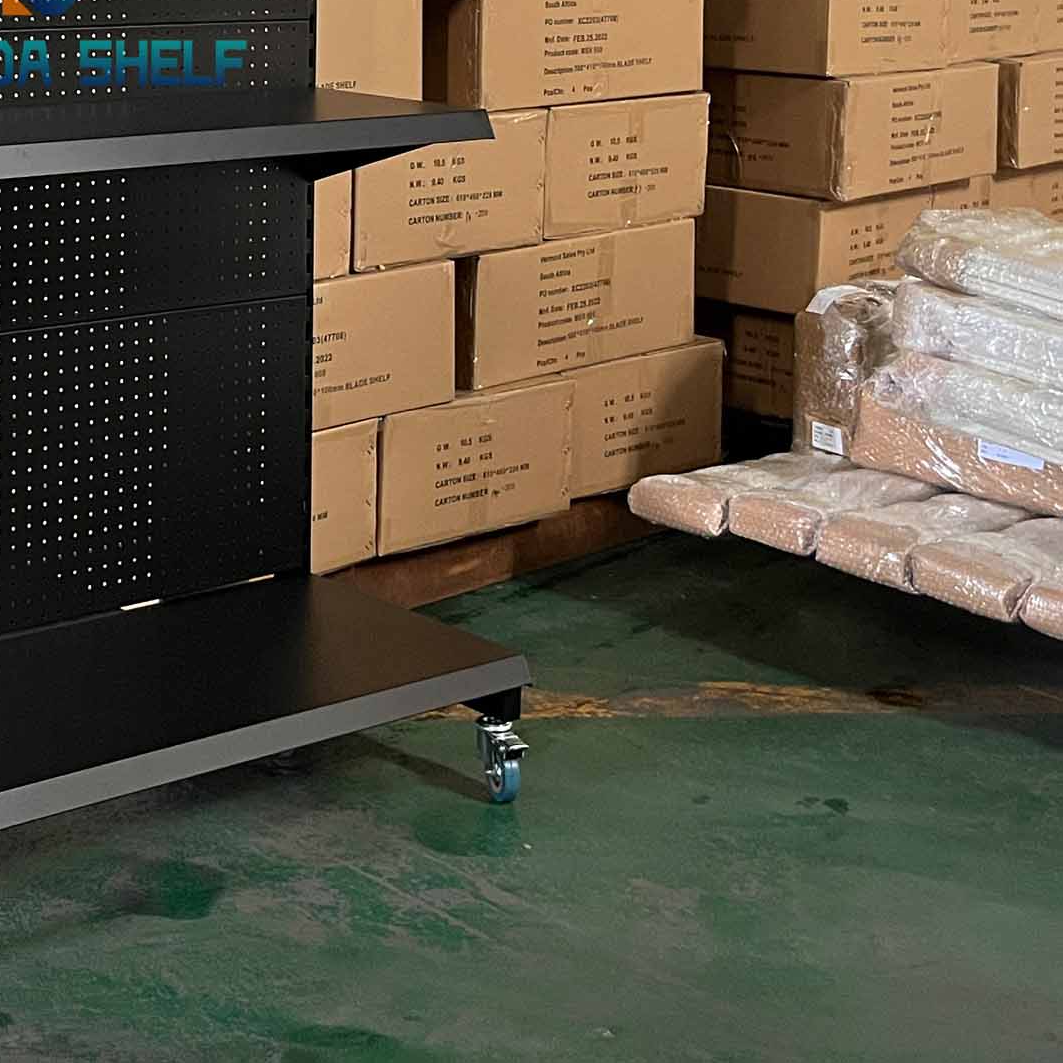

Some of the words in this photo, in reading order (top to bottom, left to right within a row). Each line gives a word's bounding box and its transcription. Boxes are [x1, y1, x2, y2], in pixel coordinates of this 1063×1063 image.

[587, 189, 610, 198] CARTON
[409, 197, 435, 207] CARTON
[408, 216, 434, 226] CARTON
[369, 373, 390, 385] SHELF
[435, 476, 461, 489] CARTON
[434, 495, 461, 507] CARTON
